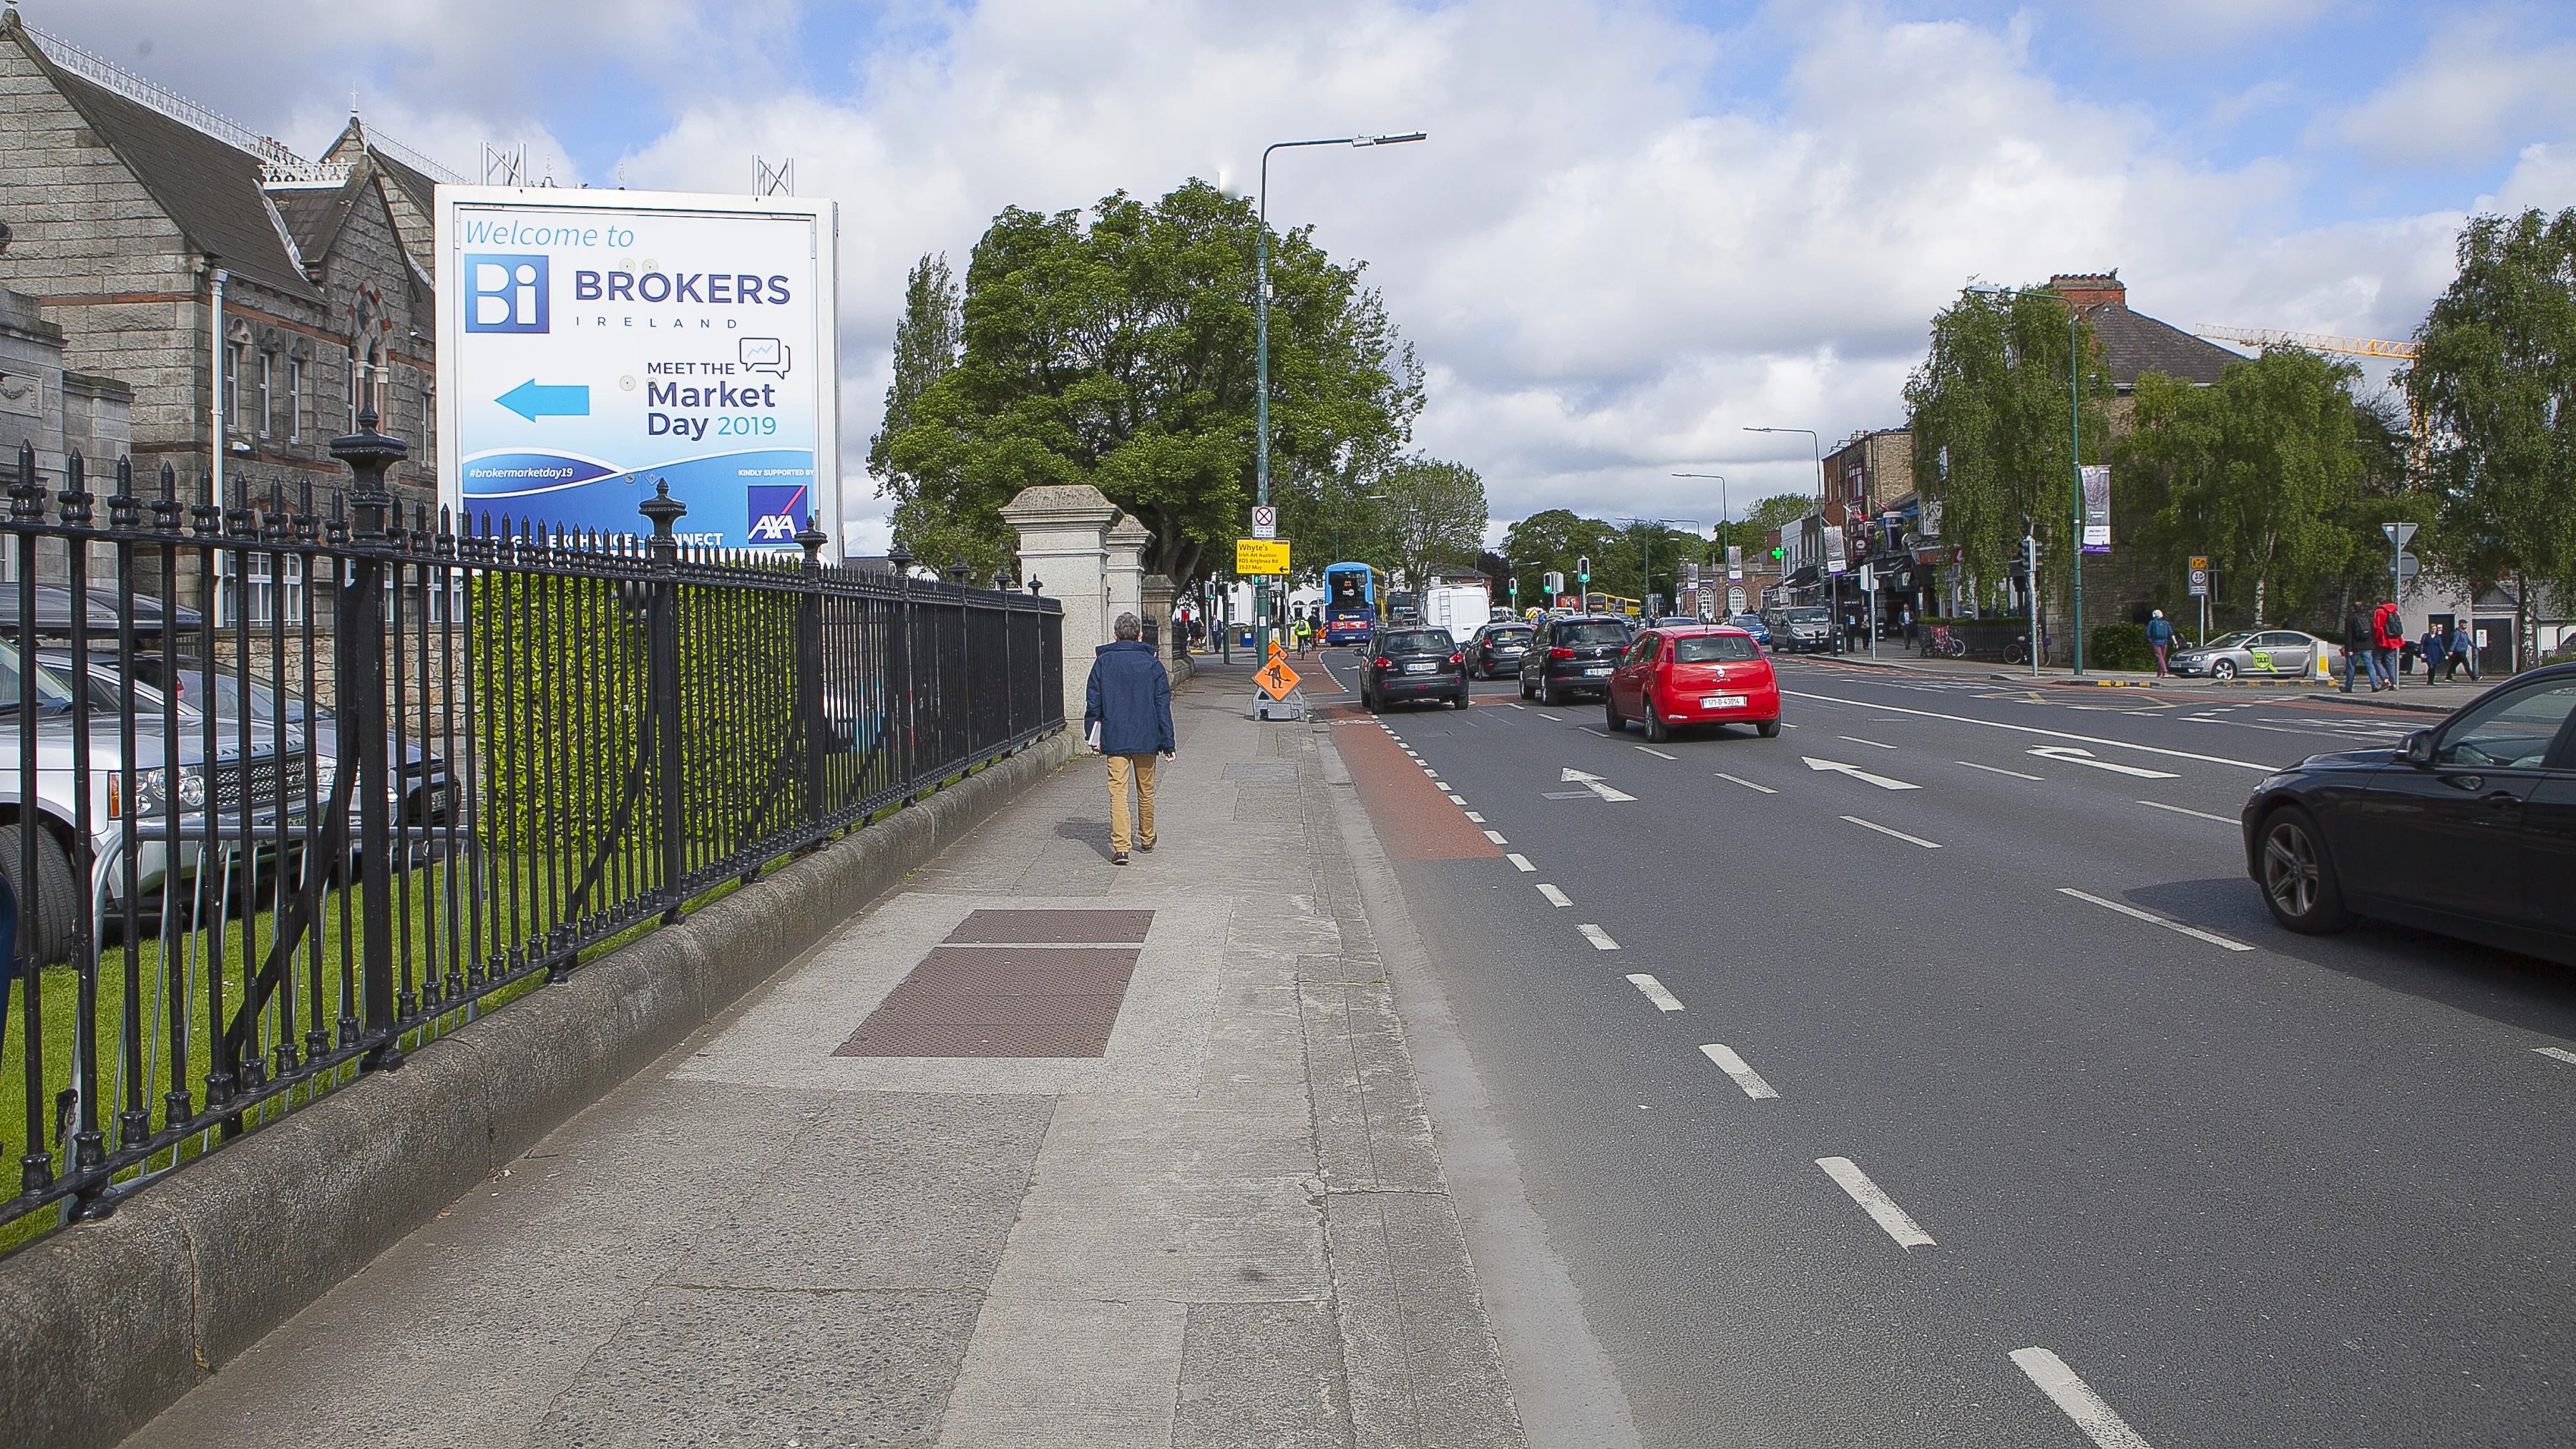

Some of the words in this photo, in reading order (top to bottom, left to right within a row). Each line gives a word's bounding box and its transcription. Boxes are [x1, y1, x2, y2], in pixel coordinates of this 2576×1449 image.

[467, 220, 597, 247] Welcome
[608, 225, 634, 248] to
[476, 263, 537, 325] Bi
[575, 270, 791, 305] BROKERS
[576, 316, 736, 328] IRELAND
[648, 362, 696, 374] MEET
[701, 362, 735, 375] THE
[648, 381, 776, 408] Market
[648, 413, 709, 441] Day
[718, 416, 776, 435] 2019
[469, 467, 573, 480] #brokermarketday19
[650, 533, 724, 546] NNECT
[747, 515, 797, 540] AXA
[1239, 544, 1268, 552] Whyte's
